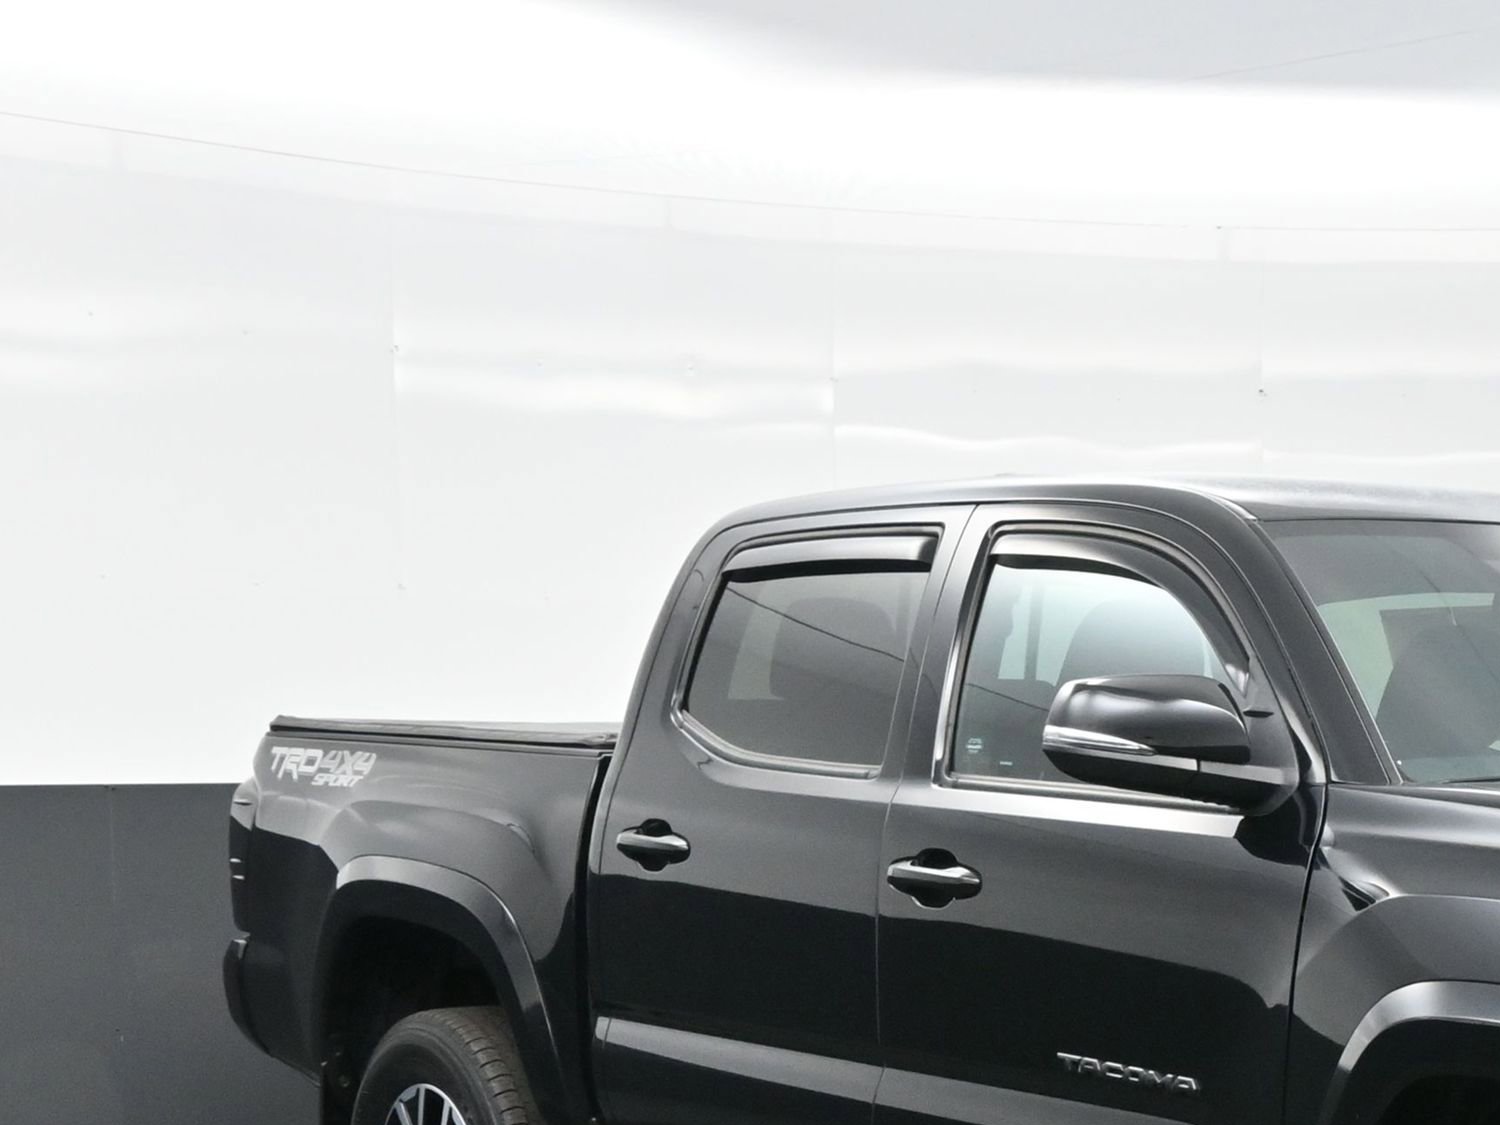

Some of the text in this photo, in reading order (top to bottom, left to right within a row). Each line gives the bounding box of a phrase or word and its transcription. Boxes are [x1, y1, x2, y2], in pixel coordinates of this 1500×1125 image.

[271, 746, 324, 781] TRD
[310, 772, 364, 788] SPORT
[1056, 1051, 1200, 1091] TACOMA
